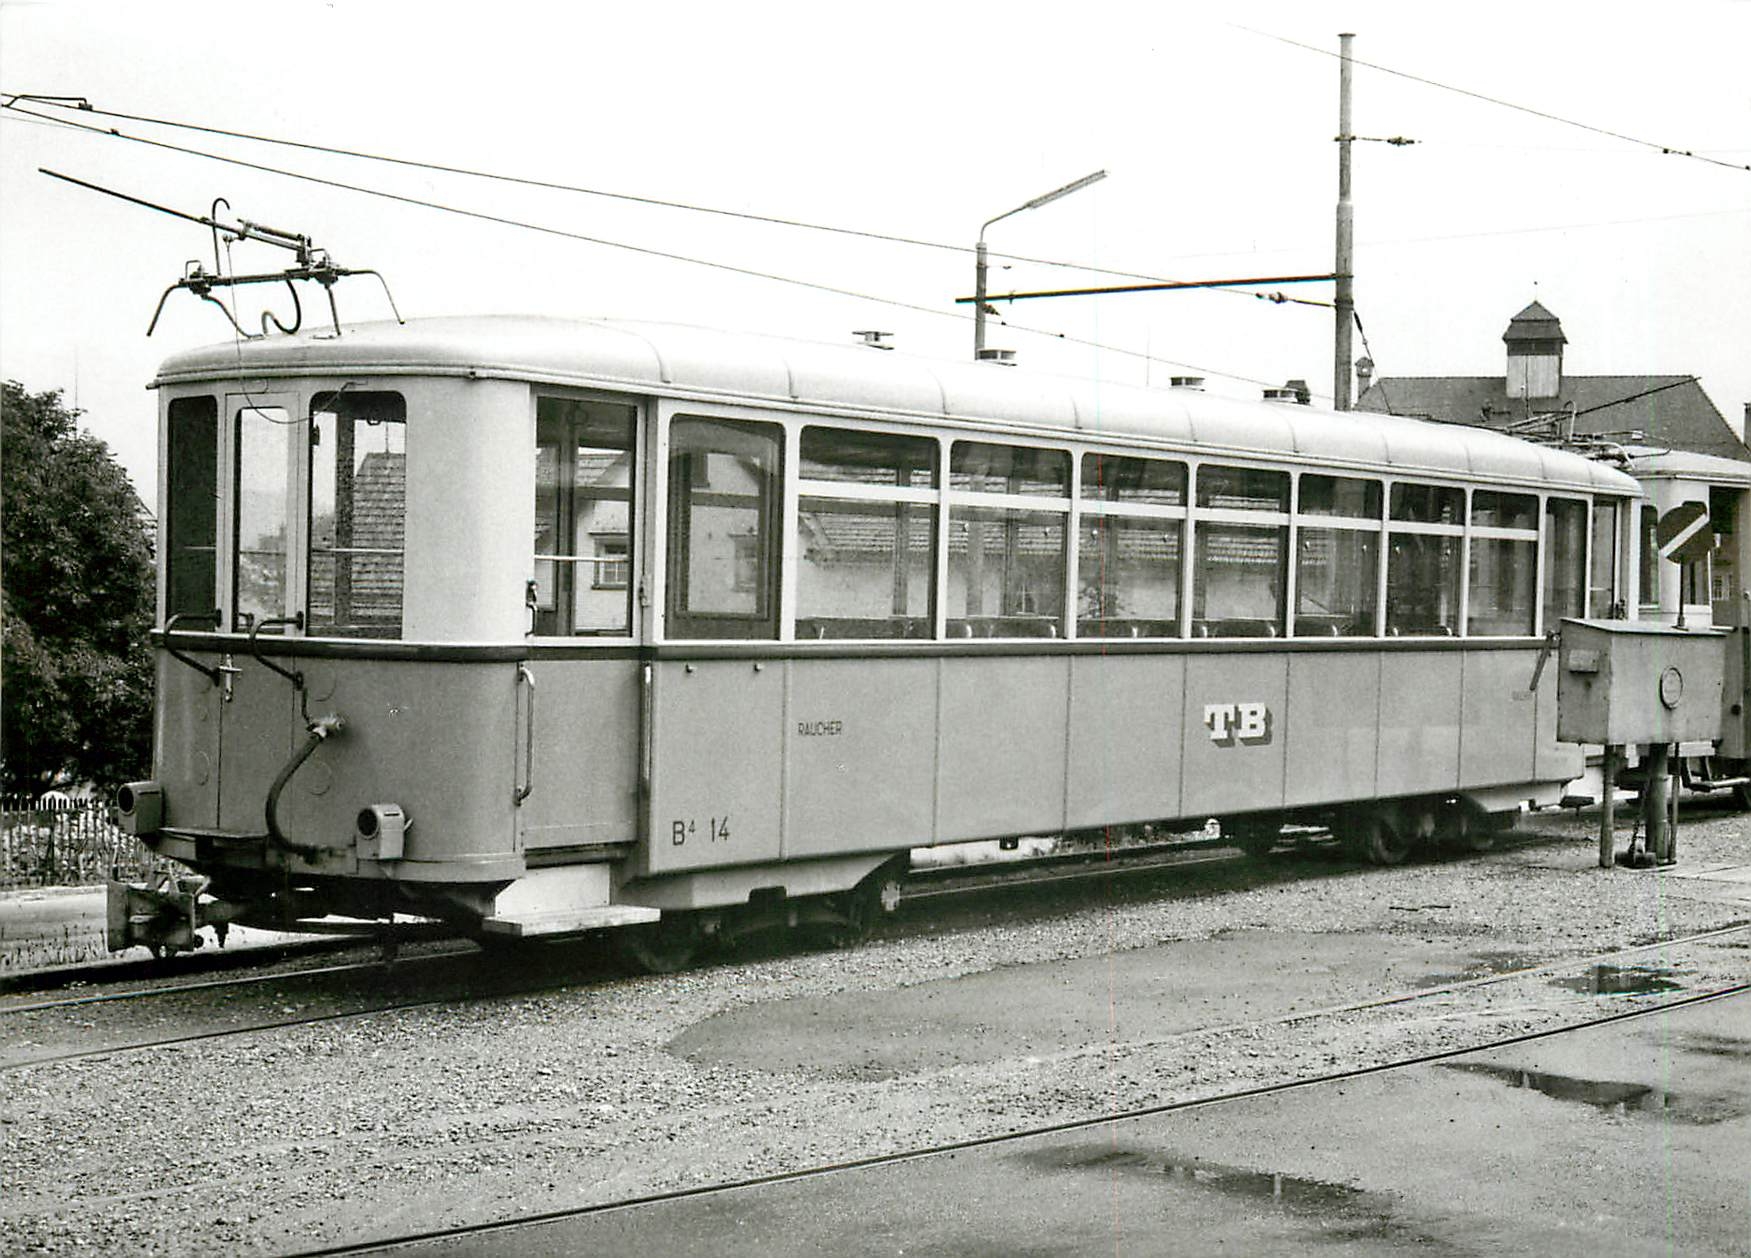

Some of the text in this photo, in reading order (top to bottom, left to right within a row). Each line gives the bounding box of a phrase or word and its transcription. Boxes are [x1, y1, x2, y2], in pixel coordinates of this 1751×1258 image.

[798, 720, 842, 736] RAUCHER
[1204, 702, 1269, 743] TB
[711, 815, 730, 843] 14
